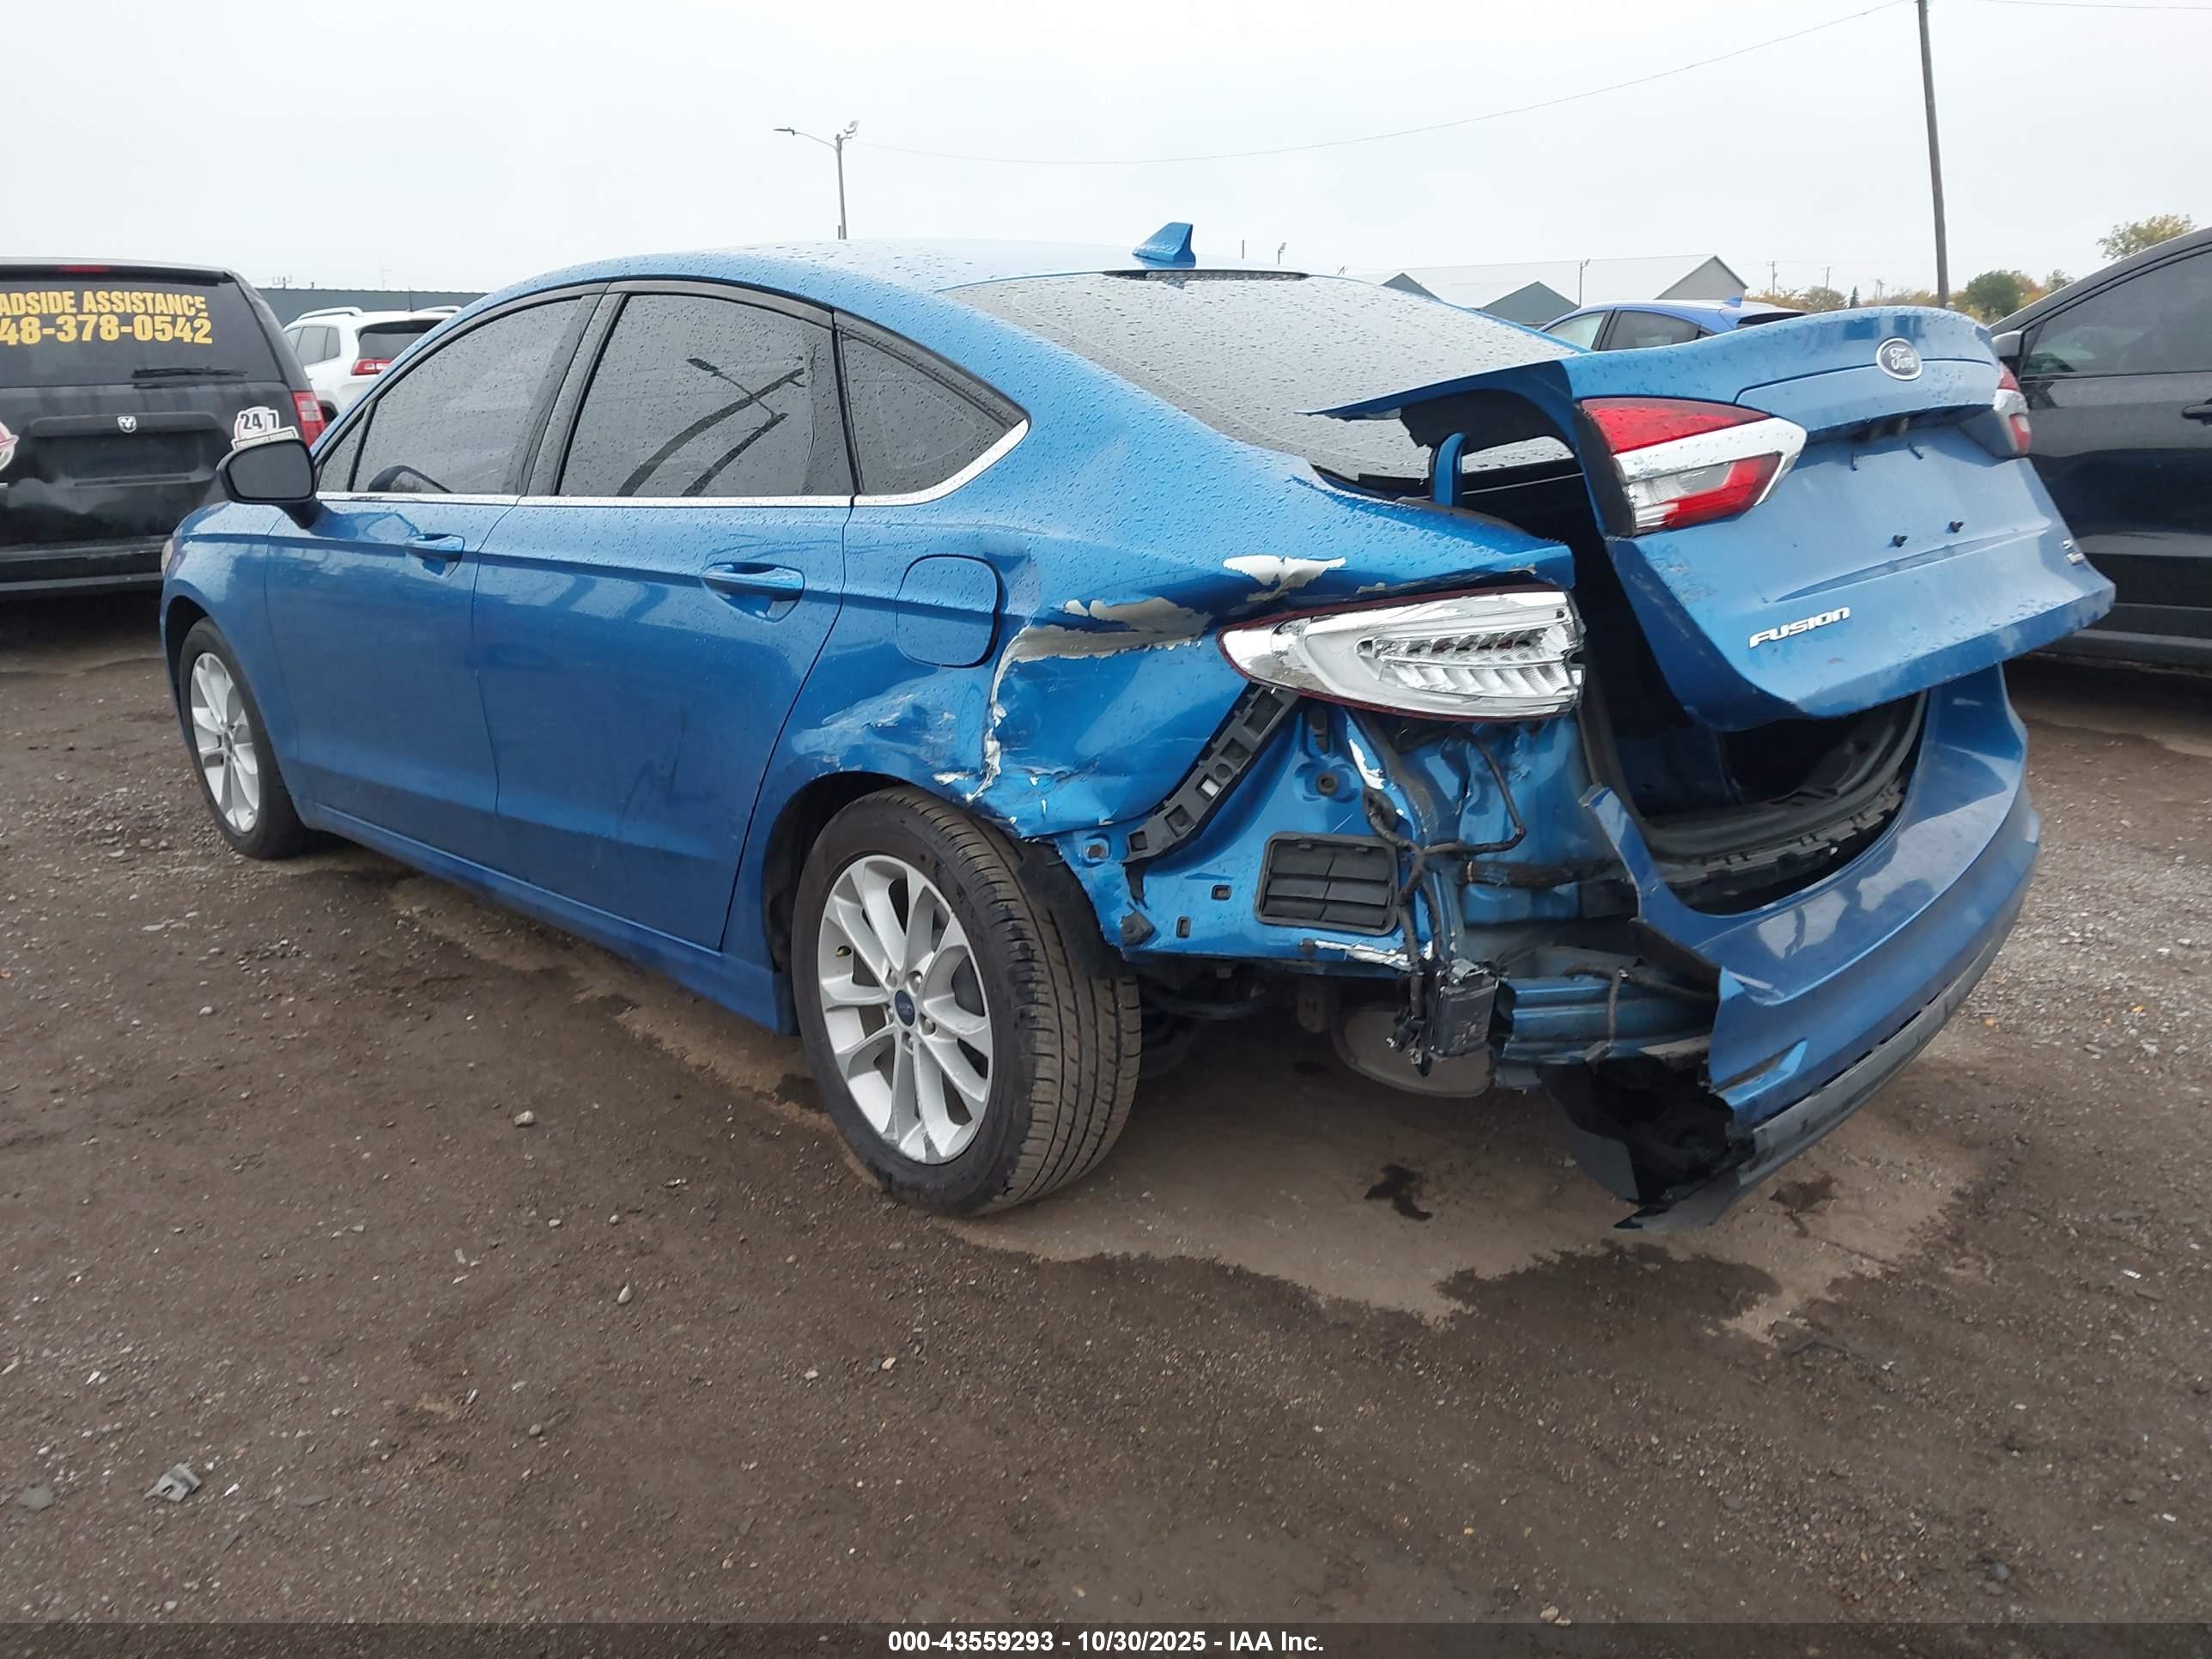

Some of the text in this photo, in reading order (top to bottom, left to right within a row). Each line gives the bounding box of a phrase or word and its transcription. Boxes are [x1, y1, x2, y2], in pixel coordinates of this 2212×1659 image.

[82, 290, 209, 318] ASSISTANCE
[0, 314, 213, 345] 48-378-0542
[1748, 606, 1850, 649] FUSION
